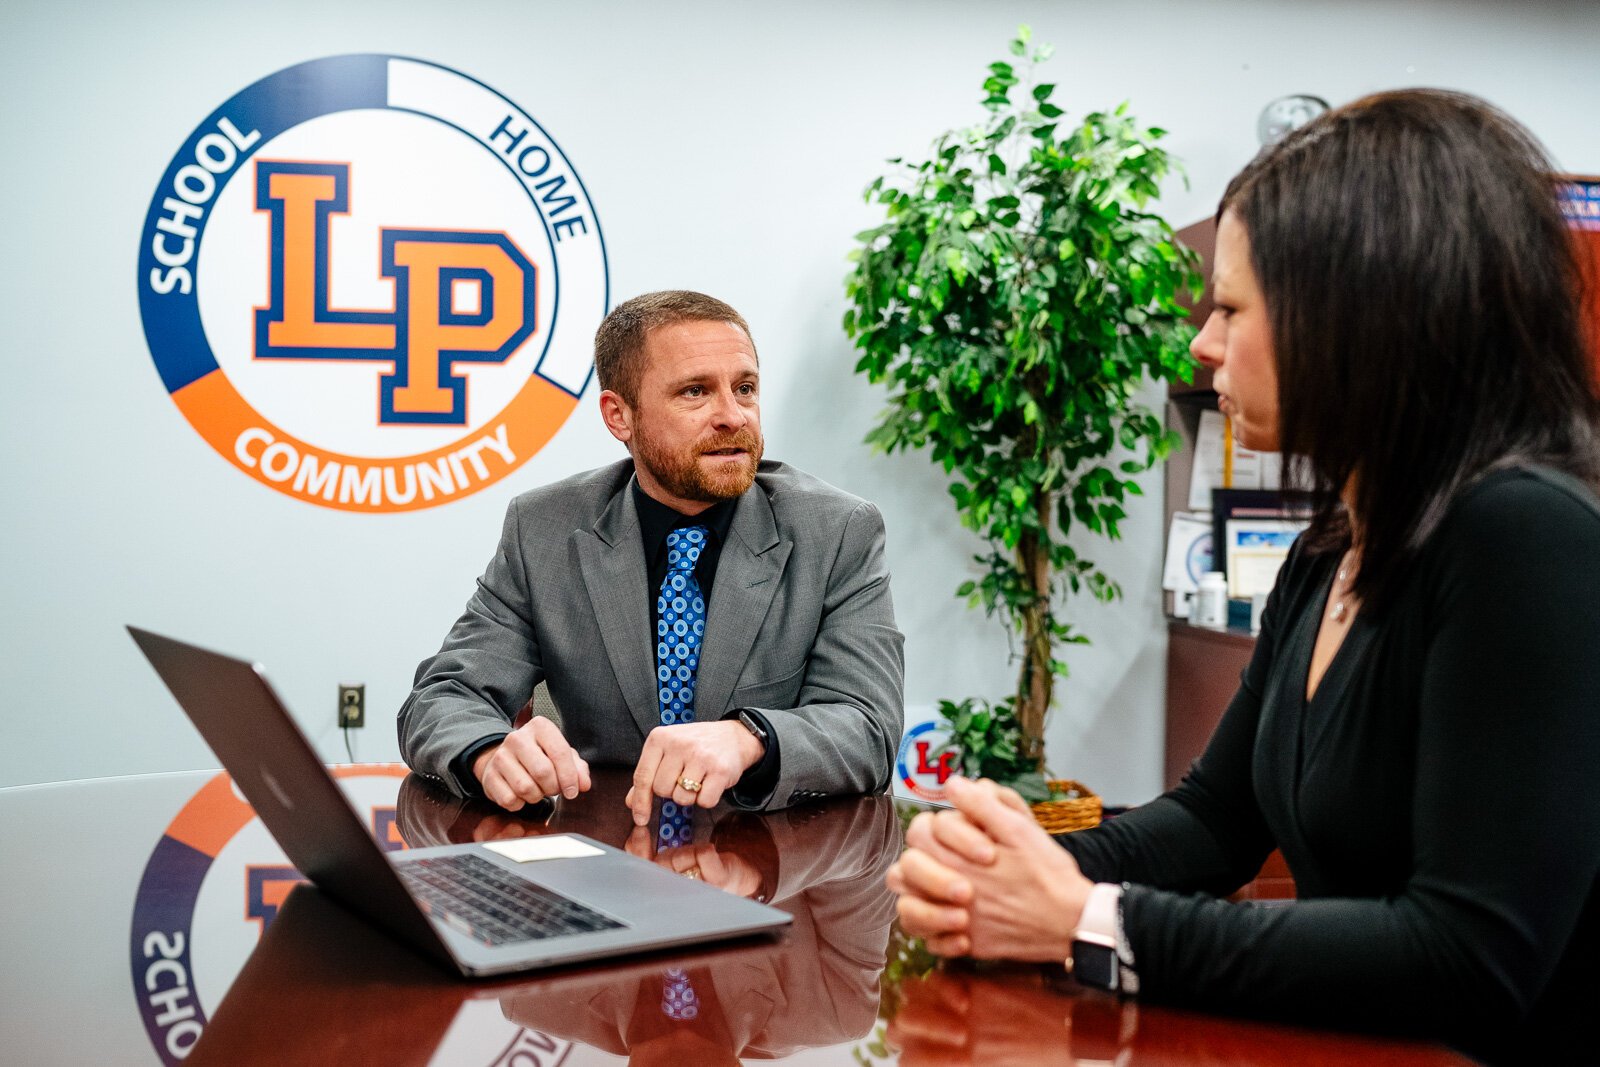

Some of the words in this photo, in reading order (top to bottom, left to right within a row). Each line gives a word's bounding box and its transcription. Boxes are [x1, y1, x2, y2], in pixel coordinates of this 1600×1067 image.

[150, 117, 261, 295] SCHOOL
[488, 115, 589, 243] HOME
[252, 157, 539, 427] LP
[234, 424, 517, 506] COMMUNITY
